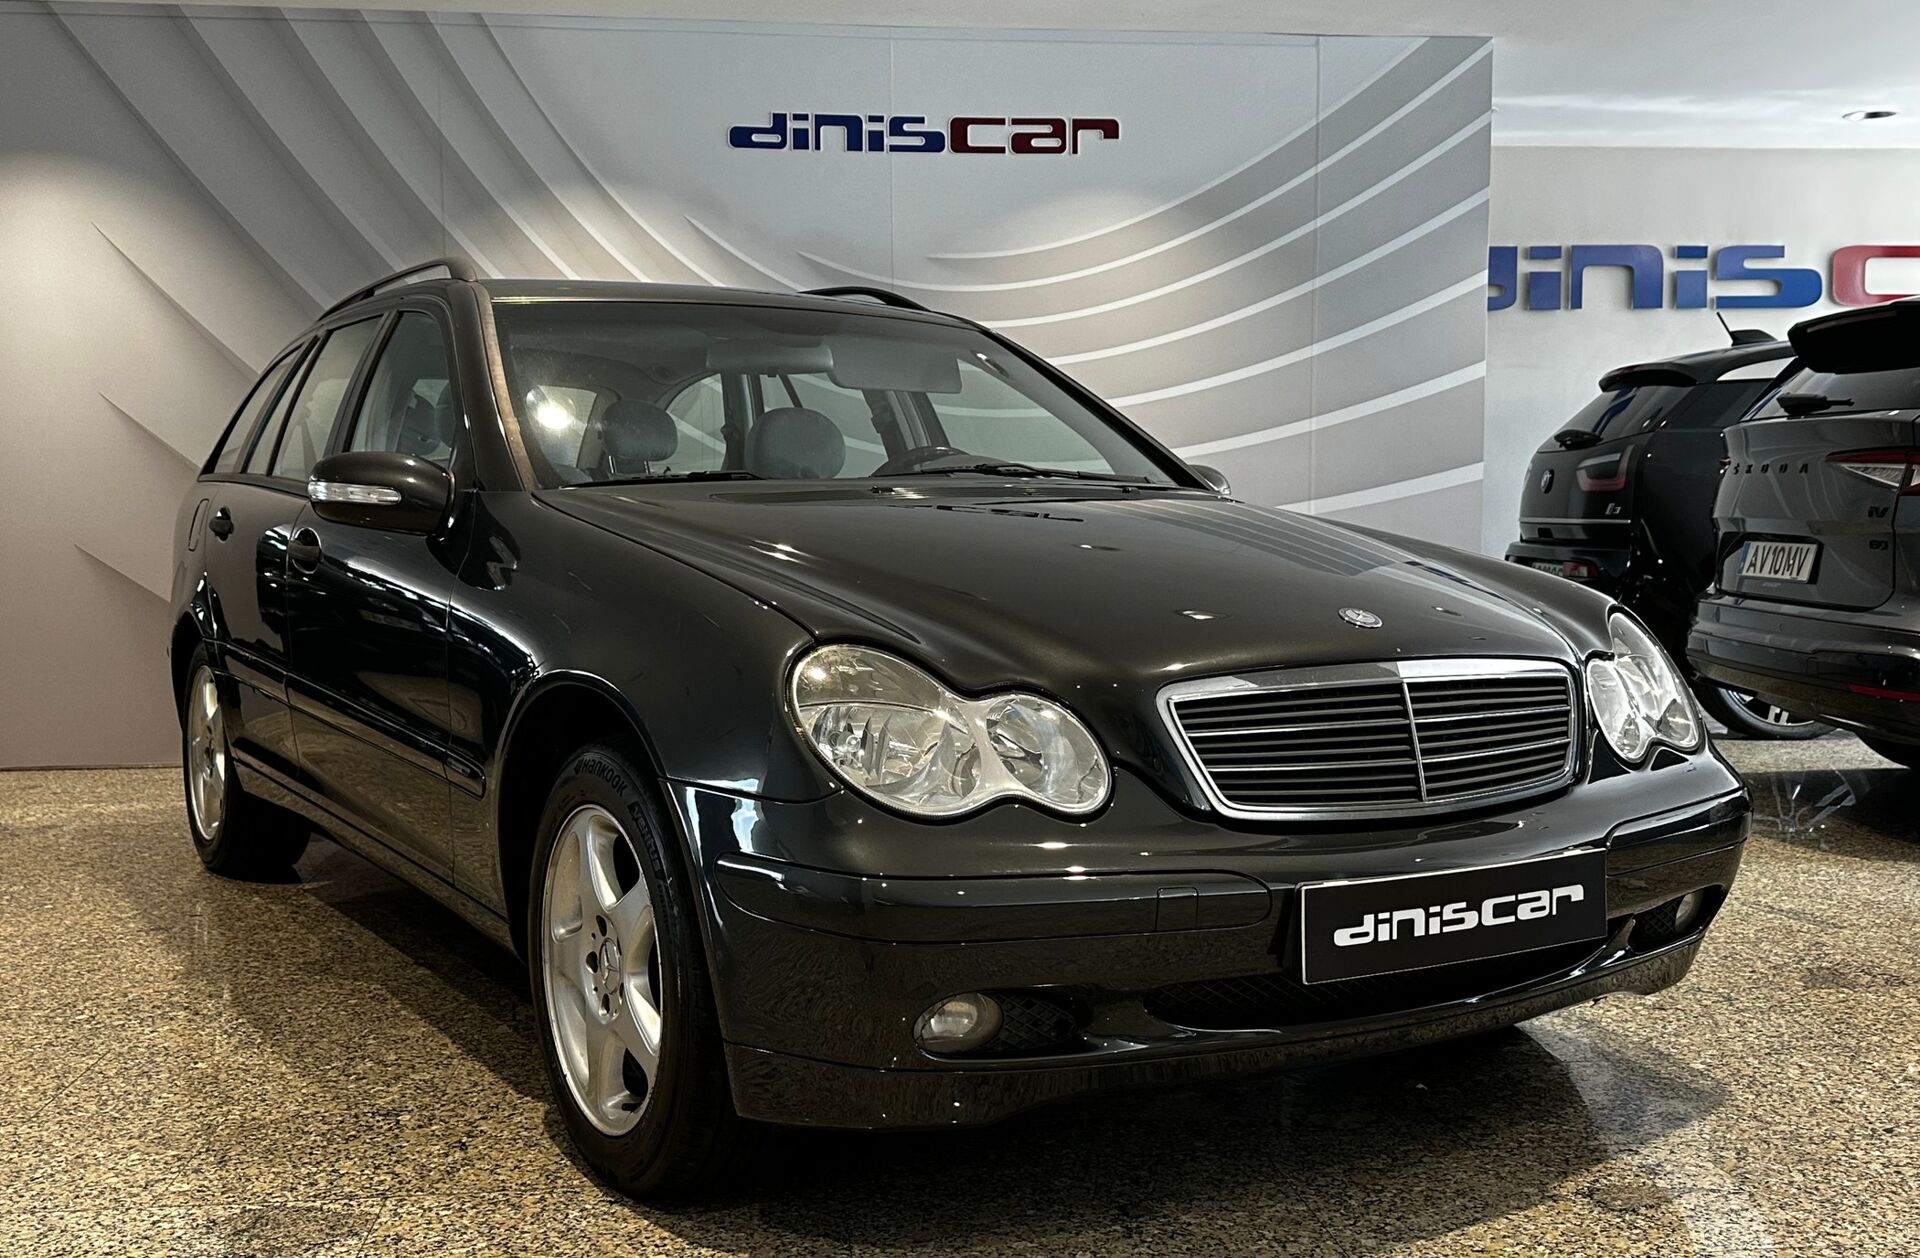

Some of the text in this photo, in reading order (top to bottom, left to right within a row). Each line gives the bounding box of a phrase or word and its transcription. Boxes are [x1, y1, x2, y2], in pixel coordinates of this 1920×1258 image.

[728, 112, 1121, 155] diniscar
[1487, 244, 1920, 312] inisc
[1746, 543, 1811, 577] AV10MV
[1333, 884, 1584, 947] diniscar
